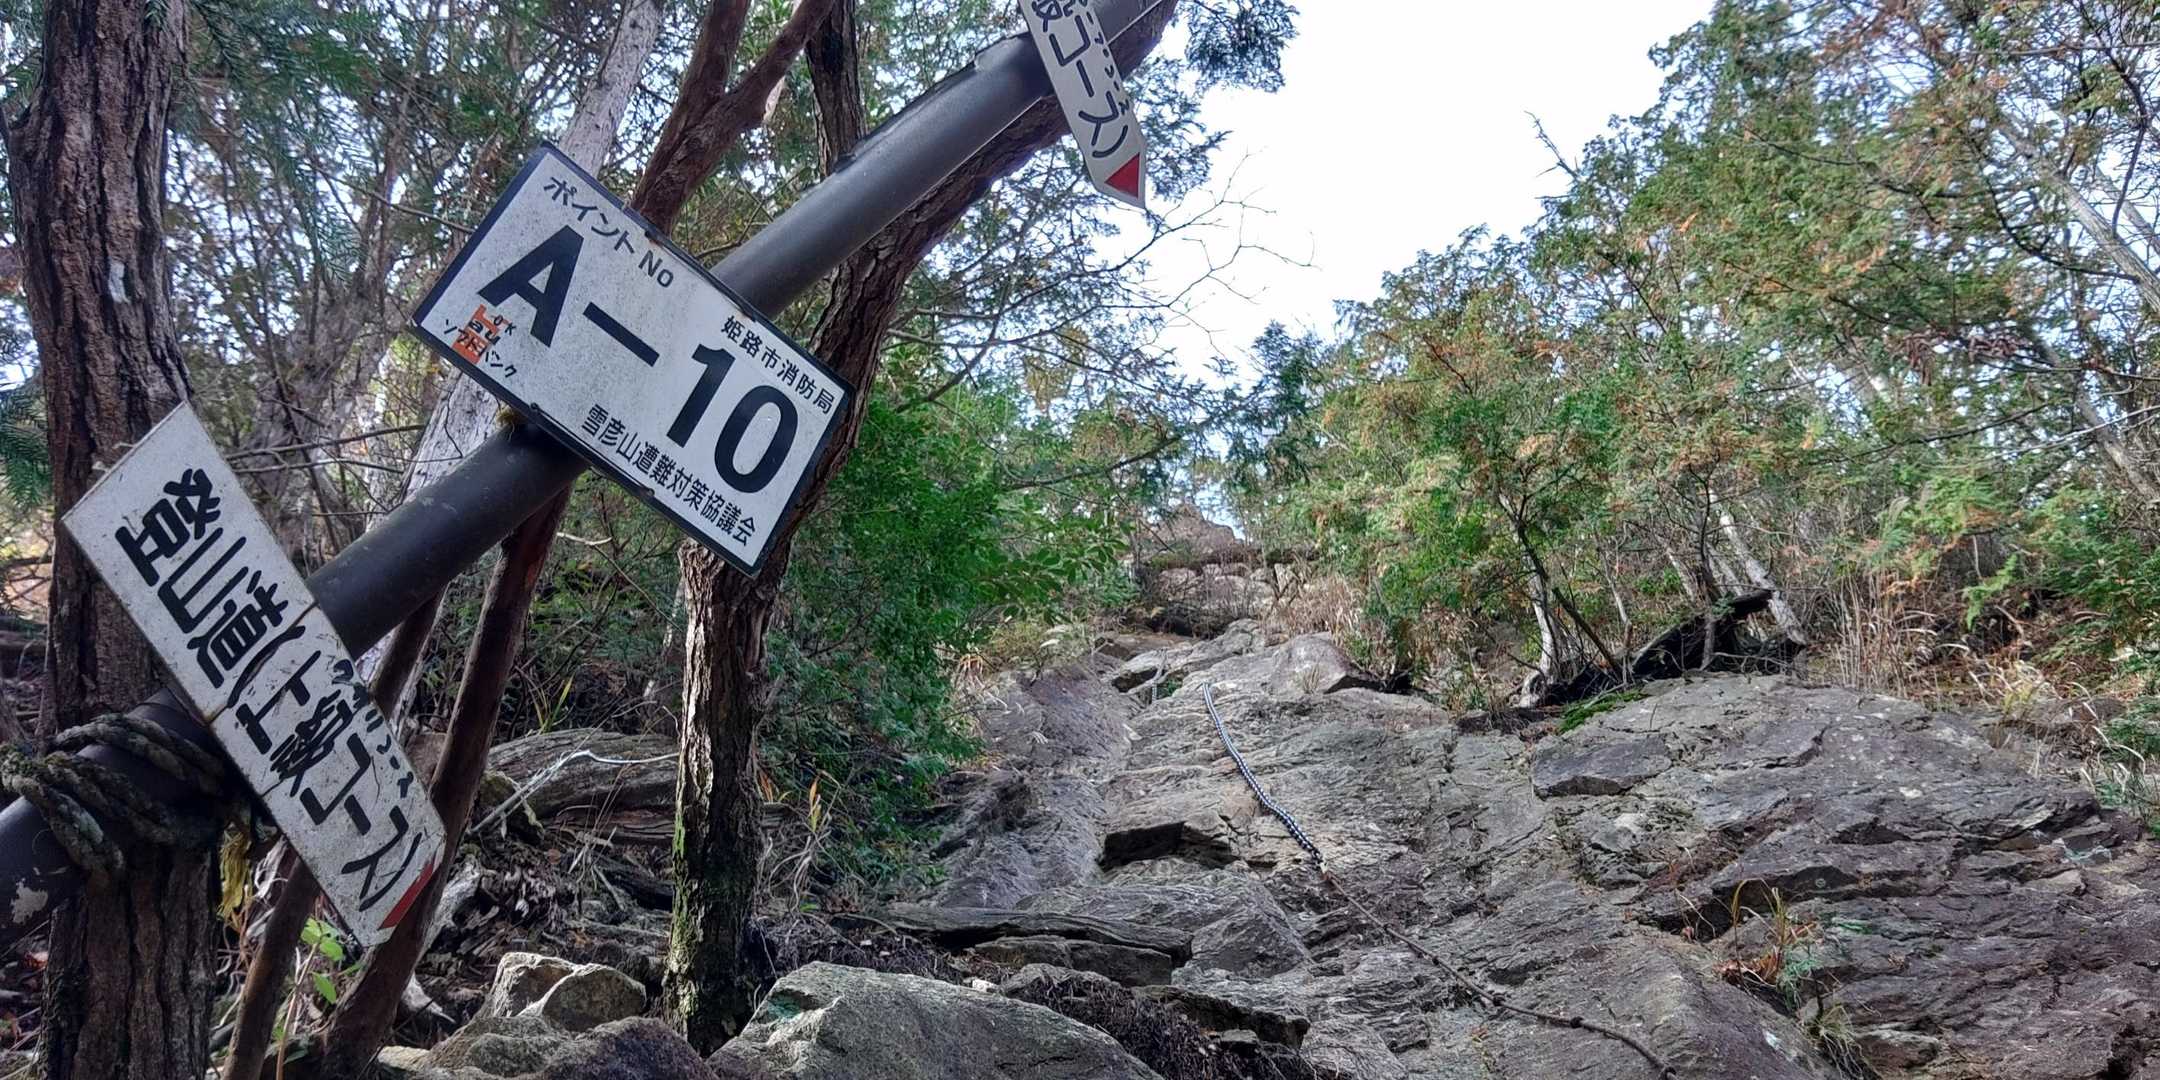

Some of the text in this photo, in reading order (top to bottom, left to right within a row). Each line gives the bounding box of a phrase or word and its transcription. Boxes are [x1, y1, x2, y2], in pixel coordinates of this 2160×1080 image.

[468, 320, 501, 345] au
[720, 315, 835, 415] 姫路市消防局
[581, 403, 756, 547] 雪彦山遭難対策協議会
